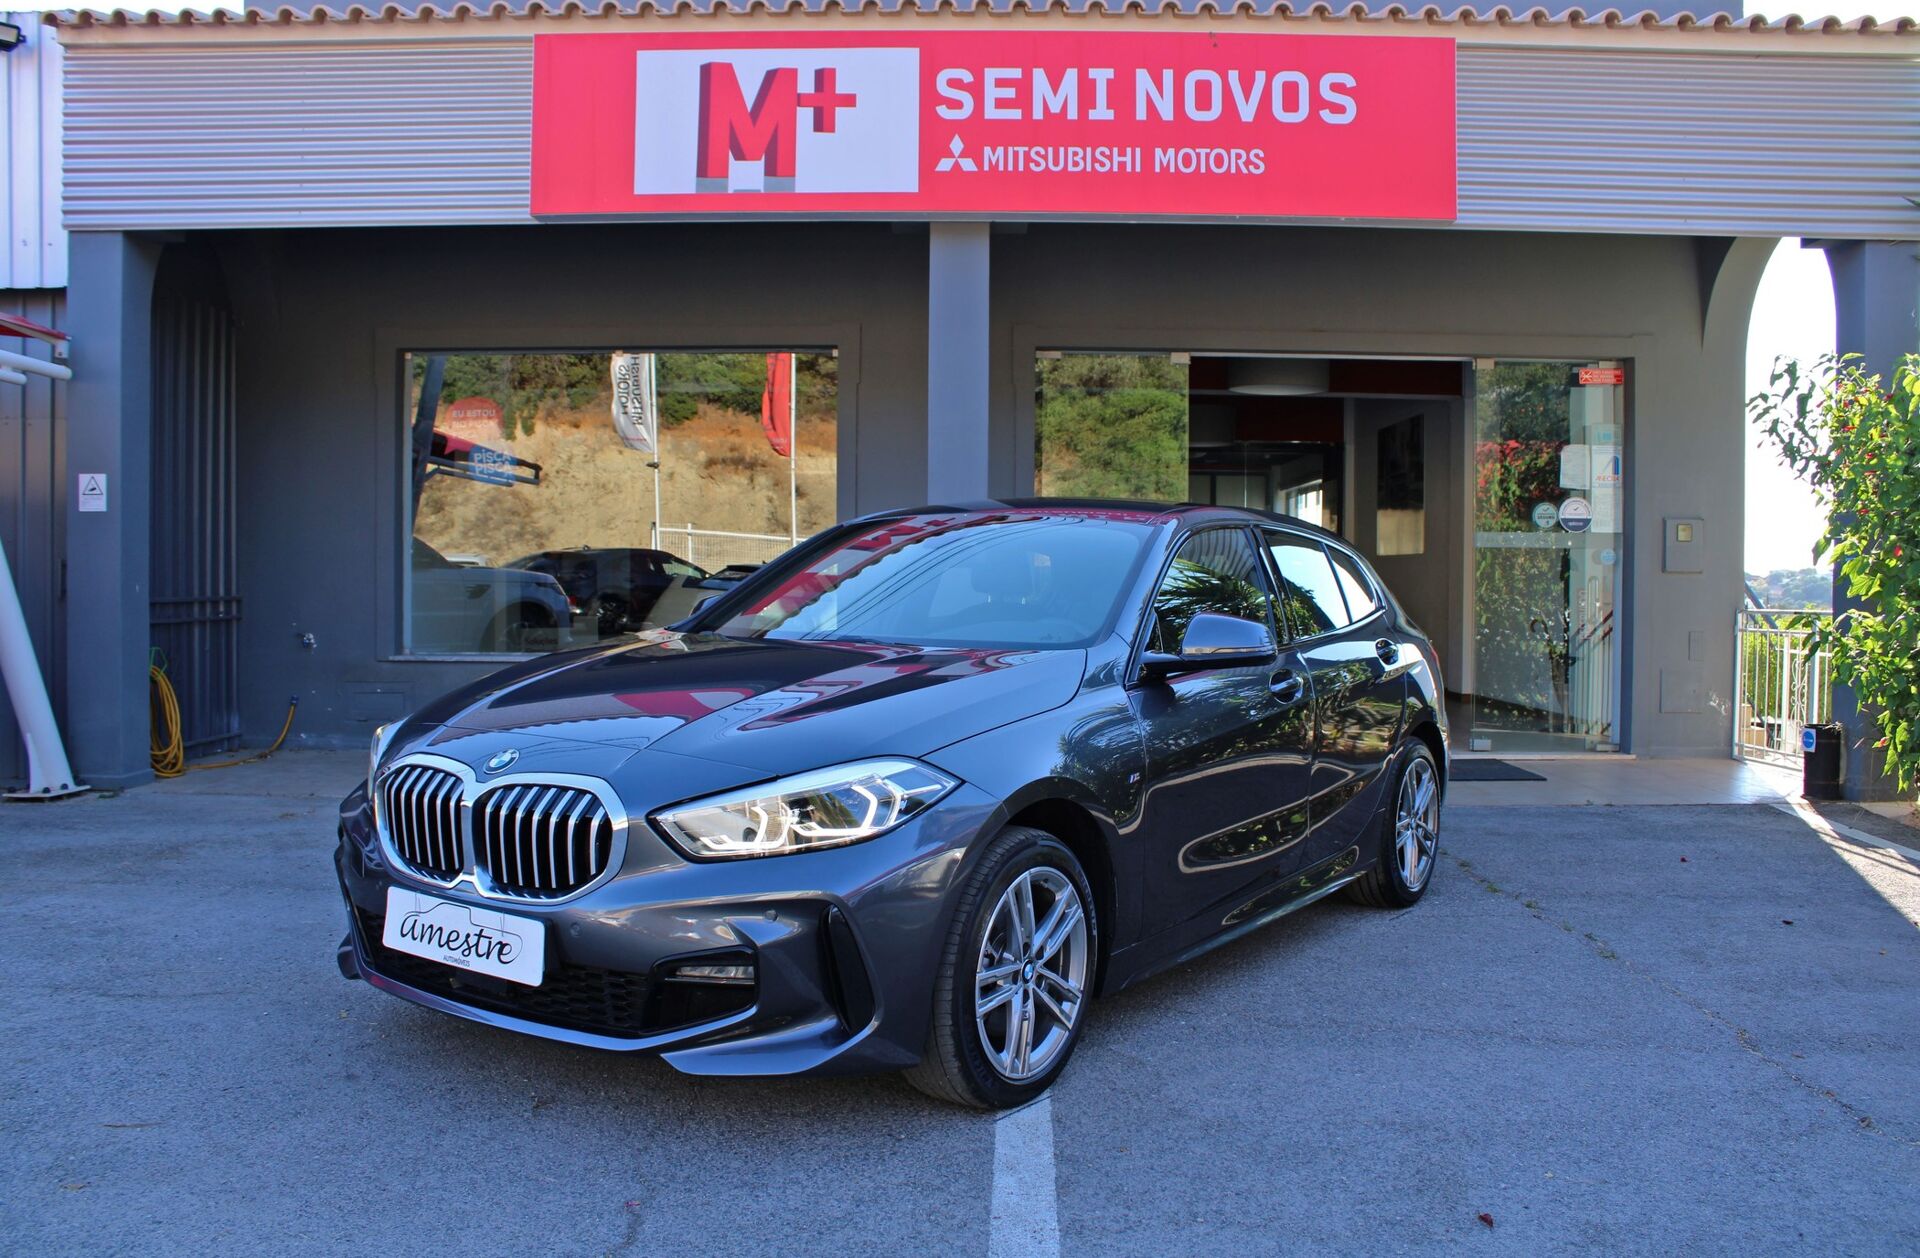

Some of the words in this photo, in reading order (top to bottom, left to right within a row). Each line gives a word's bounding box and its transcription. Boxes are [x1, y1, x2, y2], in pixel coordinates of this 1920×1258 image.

[935, 67, 1115, 120] SEMI
[1135, 68, 1357, 125] NOVOS
[983, 146, 1141, 173] MITSUBISHI
[1154, 147, 1265, 175] MOTORS
[400, 914, 513, 965] amestre
